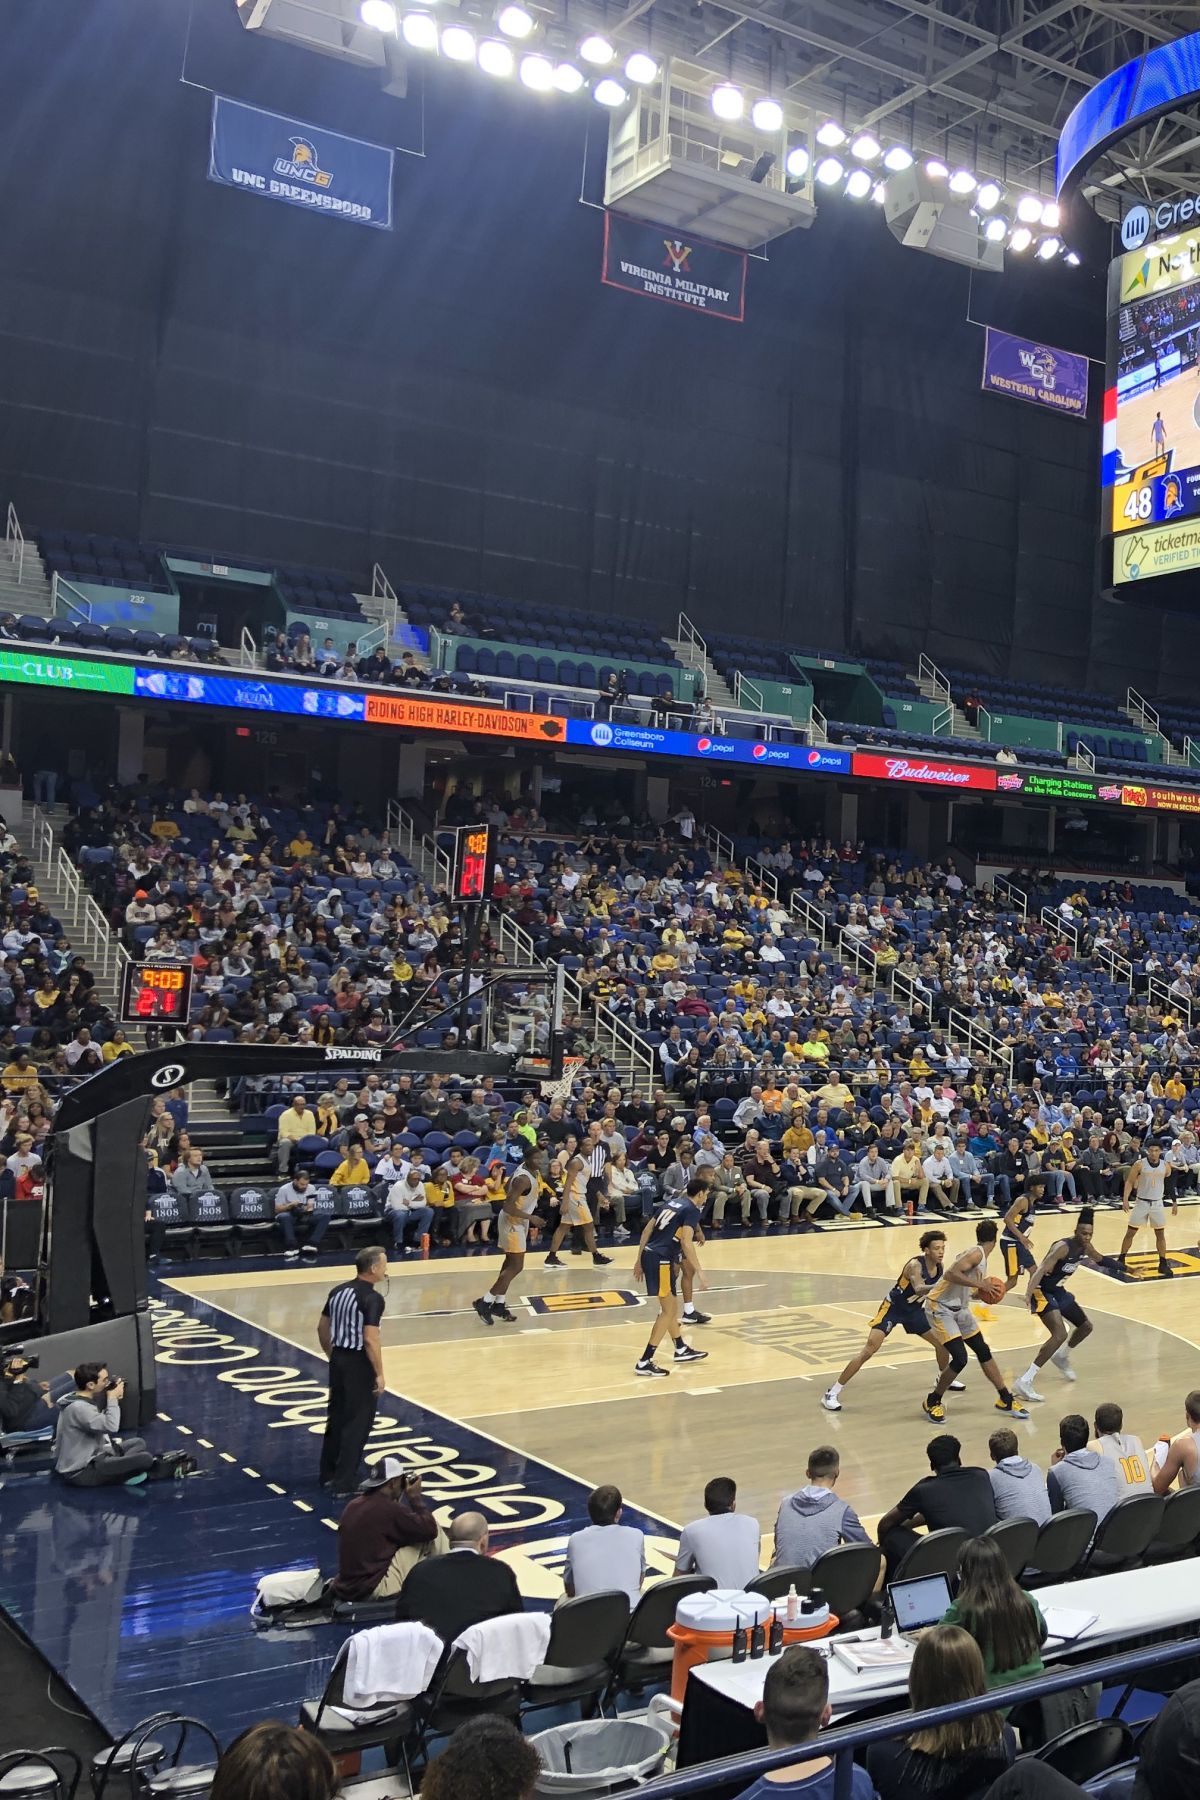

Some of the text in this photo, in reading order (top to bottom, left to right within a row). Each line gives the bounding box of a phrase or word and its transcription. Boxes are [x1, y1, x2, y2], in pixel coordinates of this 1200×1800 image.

[275, 158, 332, 188] UNCG
[231, 168, 372, 220] UNC GREENSBORO
[620, 261, 730, 302] VIRGINIA MILITARY
[644, 281, 706, 307] INSTITUTE
[990, 375, 1082, 409] WESTERN CAROLINA
[1124, 487, 1152, 522] 48
[1153, 547, 1190, 566] VERIFIED
[130, 594, 145, 604] 232
[22, 662, 73, 680] CLUB
[368, 701, 404, 720] RIDING
[409, 706, 433, 722] HIGH
[614, 727, 665, 741] Greensboro
[614, 737, 654, 748] Coliseum
[712, 744, 734, 753] pepsi
[768, 750, 790, 760] pepsi
[821, 756, 842, 766] pepsi
[885, 759, 970, 784] Budweiser
[1029, 776, 1062, 790] Charging
[1062, 779, 1094, 790] Stations
[1034, 785, 1045, 794] the
[1046, 788, 1063, 797] Main
[1063, 790, 1097, 800] Concourse
[1152, 792, 1196, 804] southwest
[468, 833, 487, 853] 9:03
[462, 856, 484, 895] 21
[143, 970, 184, 989] 9:03
[136, 988, 176, 1015] 21
[325, 1047, 382, 1061] SPALDING
[156, 1208, 179, 1217] 1808
[198, 1206, 222, 1216] 1808
[240, 1204, 263, 1213] 1808
[314, 1200, 335, 1209] 1808
[349, 1199, 370, 1209] 1808
[655, 1209, 676, 1230] 14
[1119, 1455, 1146, 1484] 10
